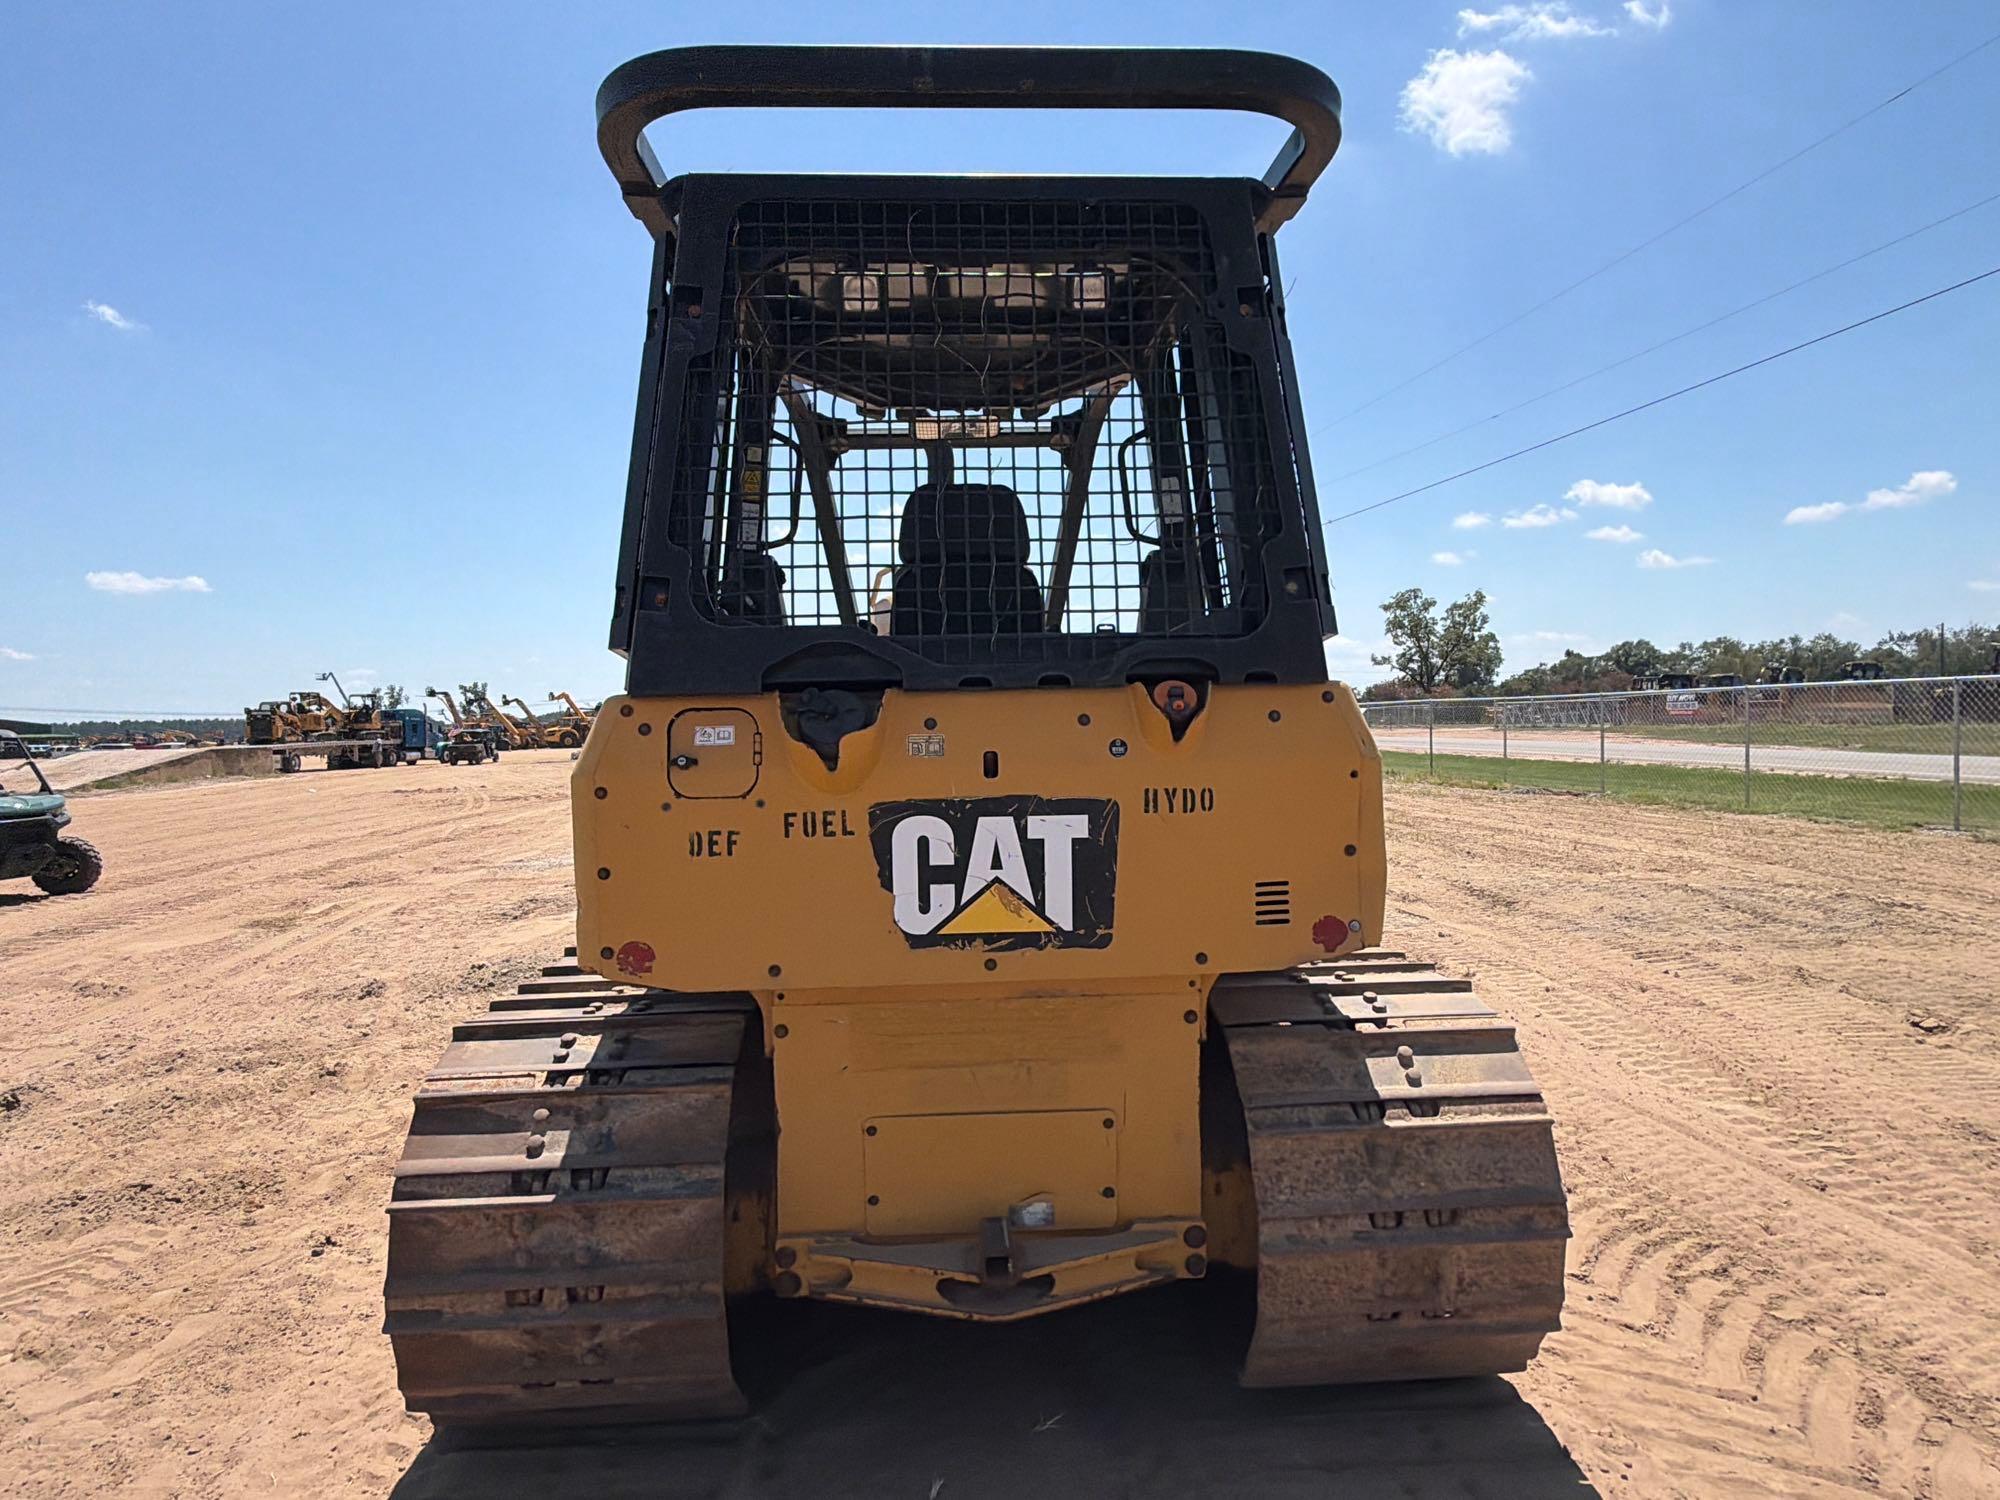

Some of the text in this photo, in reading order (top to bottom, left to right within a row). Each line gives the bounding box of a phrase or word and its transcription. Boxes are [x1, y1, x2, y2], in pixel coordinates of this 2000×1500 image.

[1143, 788, 1214, 814] HYDO
[783, 810, 855, 838] FUEL
[689, 831, 740, 857] DEF
[892, 814, 1089, 935] CAT
